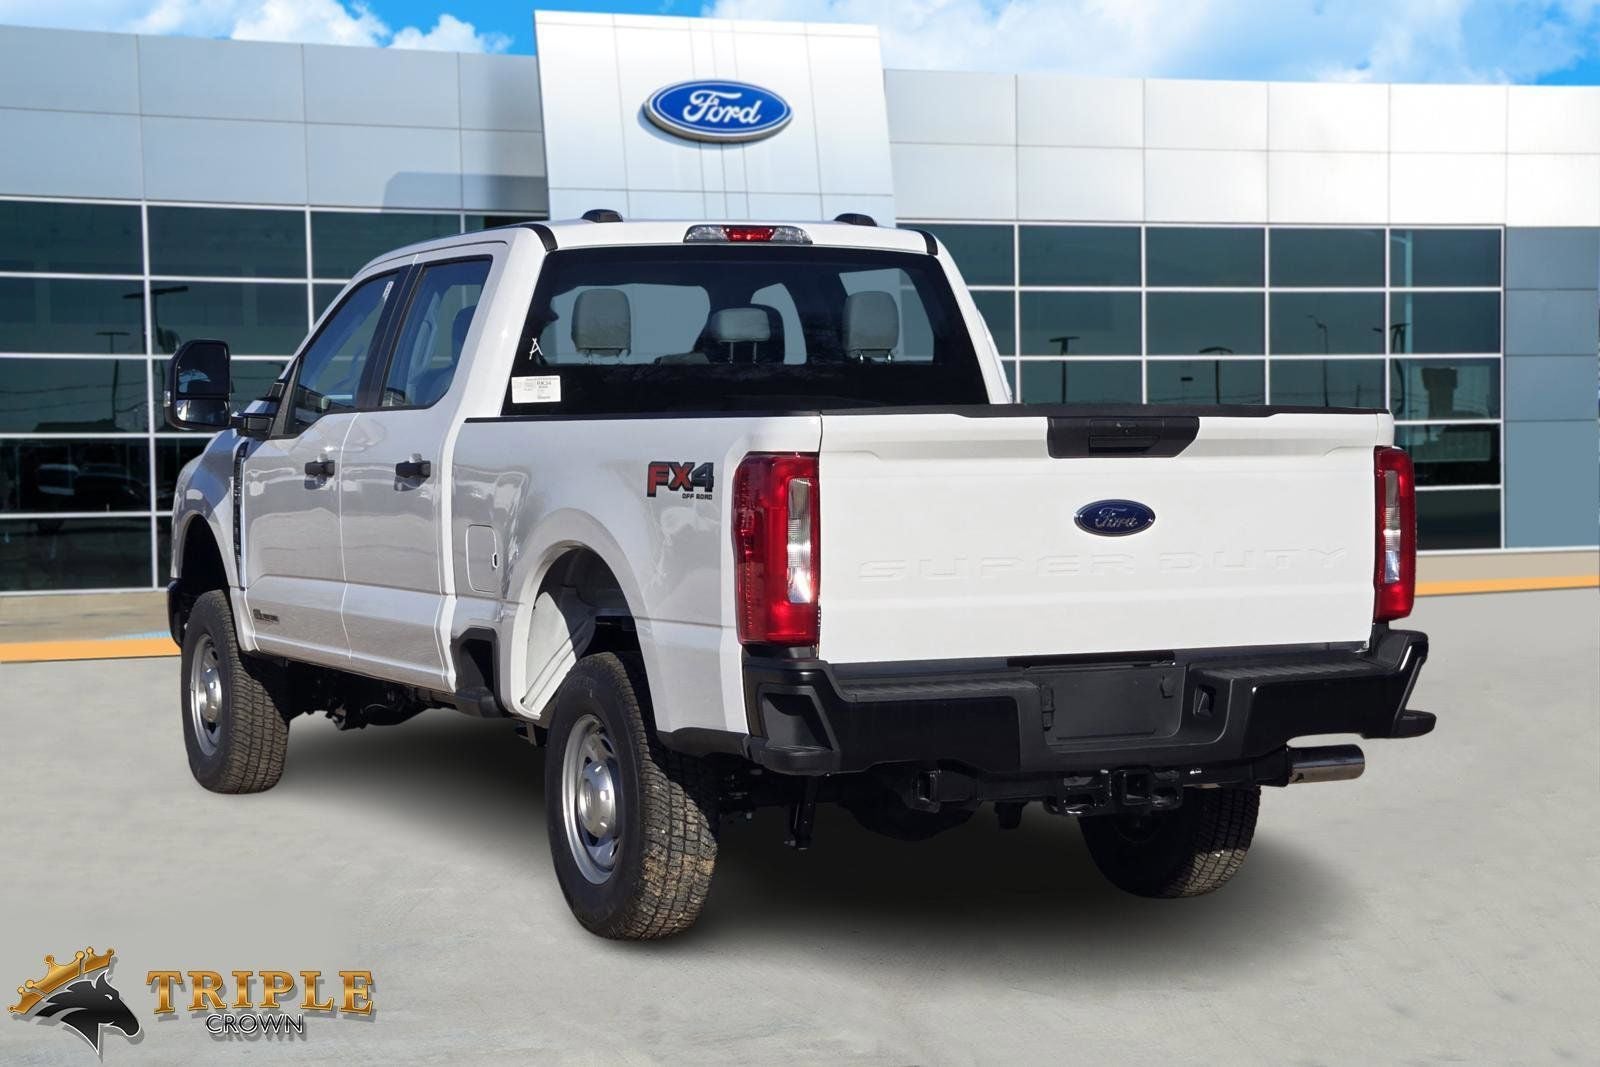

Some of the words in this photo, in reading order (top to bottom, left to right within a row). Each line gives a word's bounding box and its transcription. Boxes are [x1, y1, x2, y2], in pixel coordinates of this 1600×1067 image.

[682, 90, 762, 123] Ford
[647, 461, 714, 497] FX4
[1095, 507, 1138, 528] Ford
[856, 552, 1135, 583] SUPER
[1159, 547, 1346, 575] DUTY
